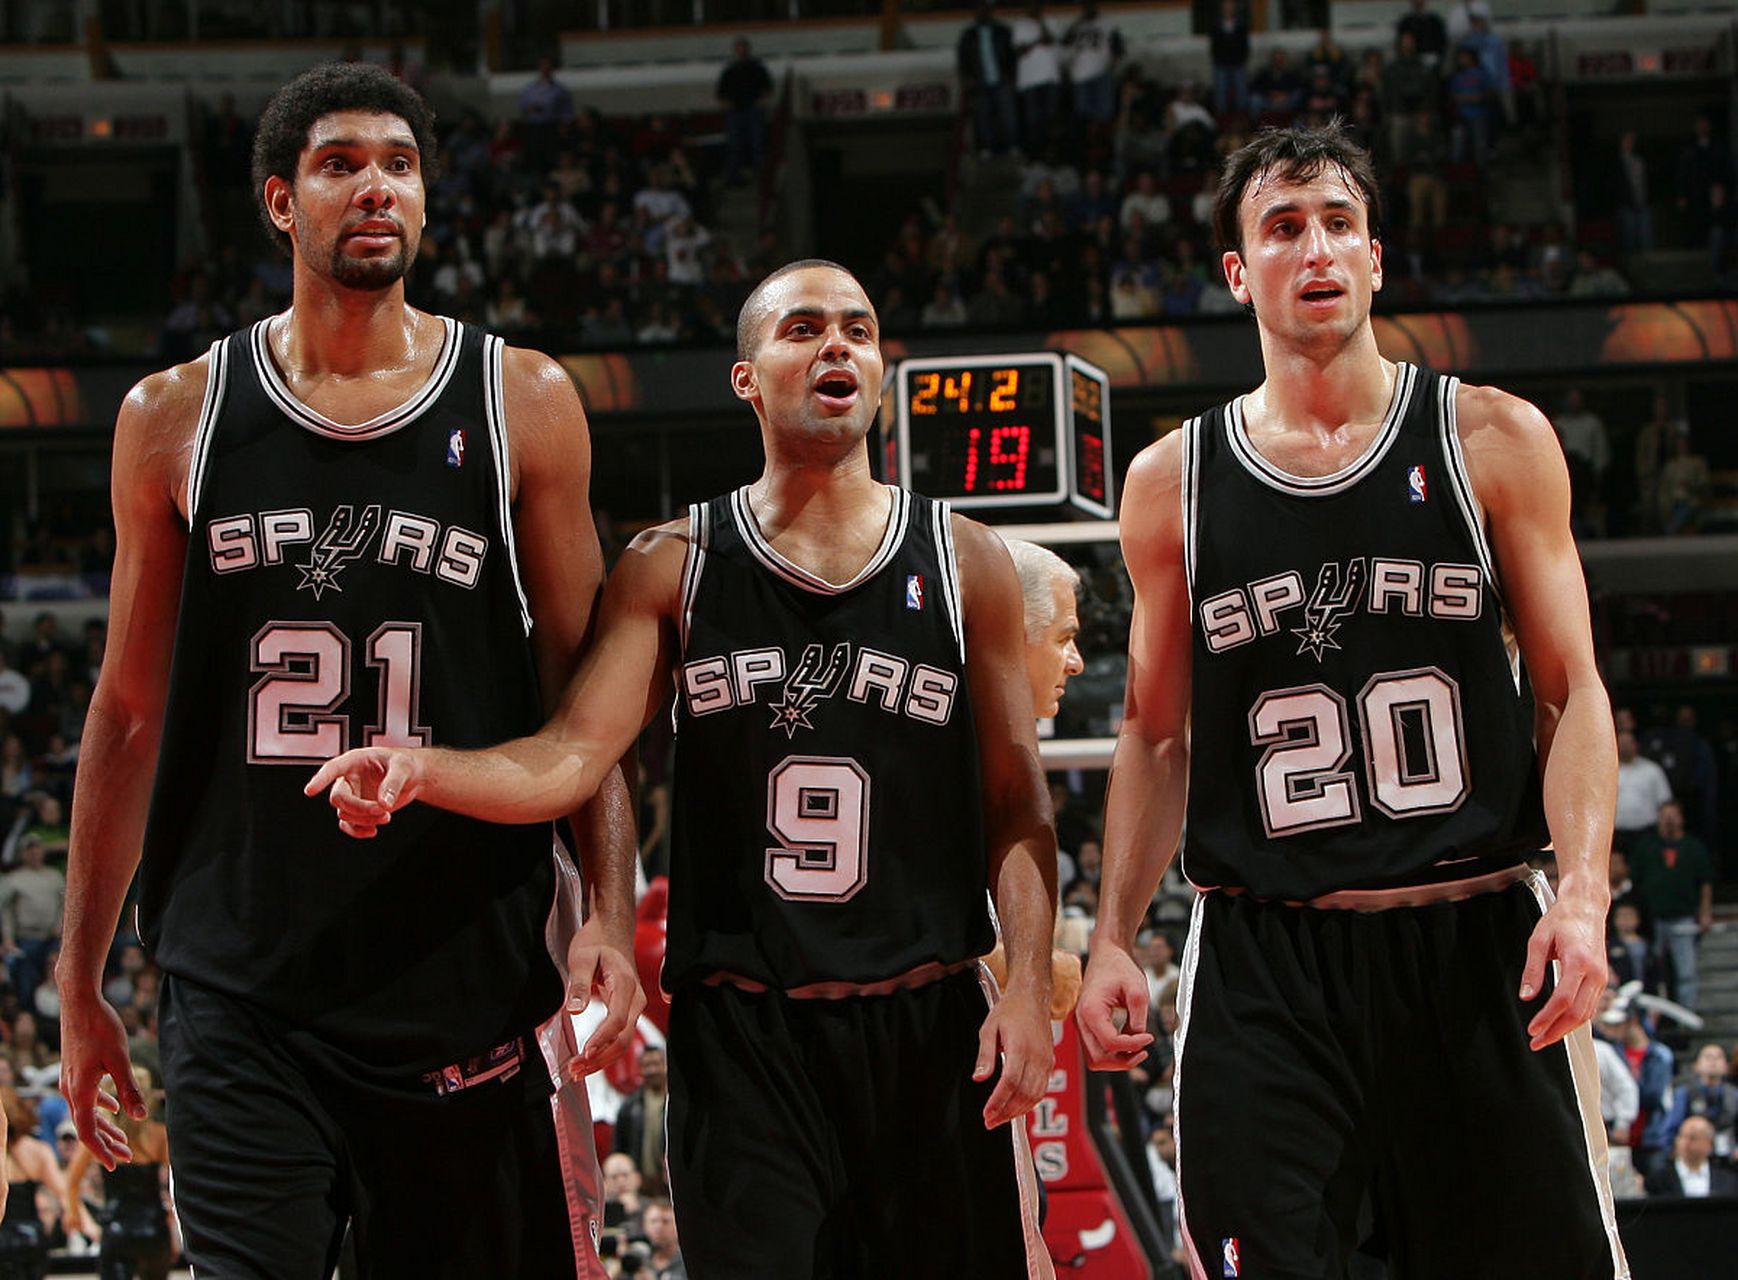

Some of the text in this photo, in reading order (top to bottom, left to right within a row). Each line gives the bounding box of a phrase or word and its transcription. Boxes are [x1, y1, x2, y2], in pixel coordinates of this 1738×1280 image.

[911, 369, 1019, 416] 24.2
[963, 425, 1030, 492] 19
[207, 504, 488, 601] SPURS
[1200, 557, 1485, 662] SPURS
[247, 620, 432, 766] 21
[683, 641, 958, 740] SPURS
[1247, 666, 1472, 840] 20
[764, 755, 871, 903] 9
[1031, 1020, 1070, 1182] LS
